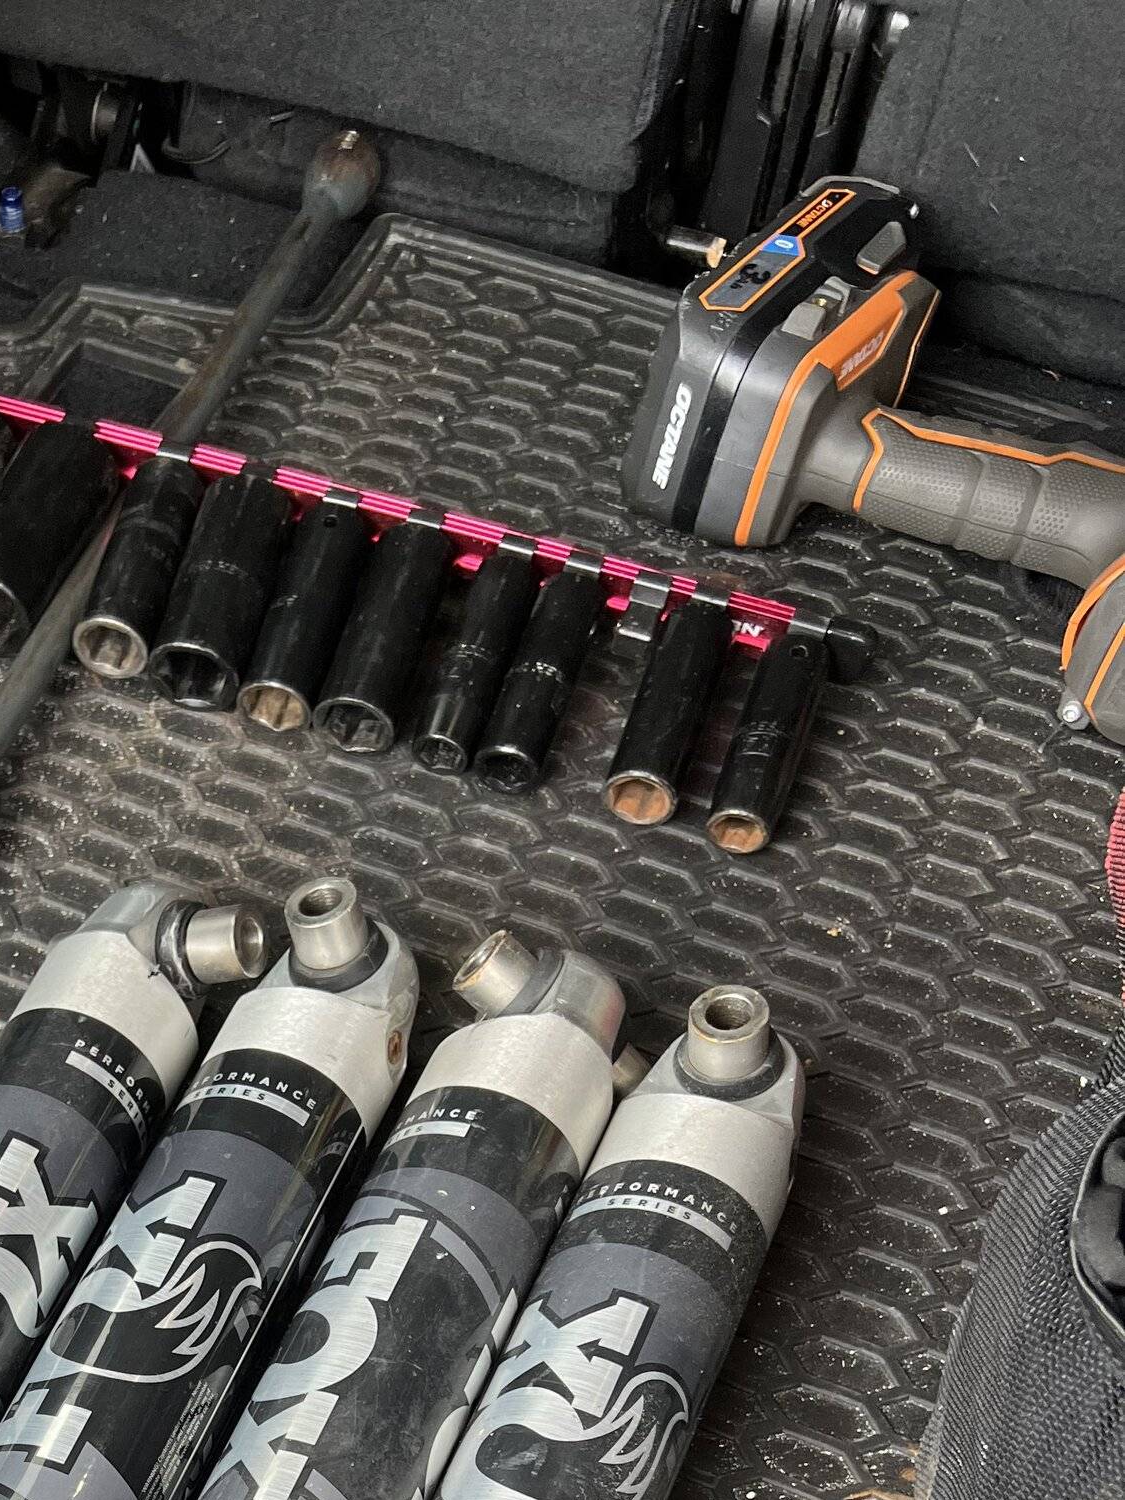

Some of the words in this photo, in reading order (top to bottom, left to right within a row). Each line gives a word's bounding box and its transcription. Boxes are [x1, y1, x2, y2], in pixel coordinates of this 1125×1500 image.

[796, 199, 833, 229] OCTANE
[651, 382, 692, 490] OCTANE
[74, 1038, 151, 1114] PERFORM
[606, 1197, 693, 1221] SERIES
